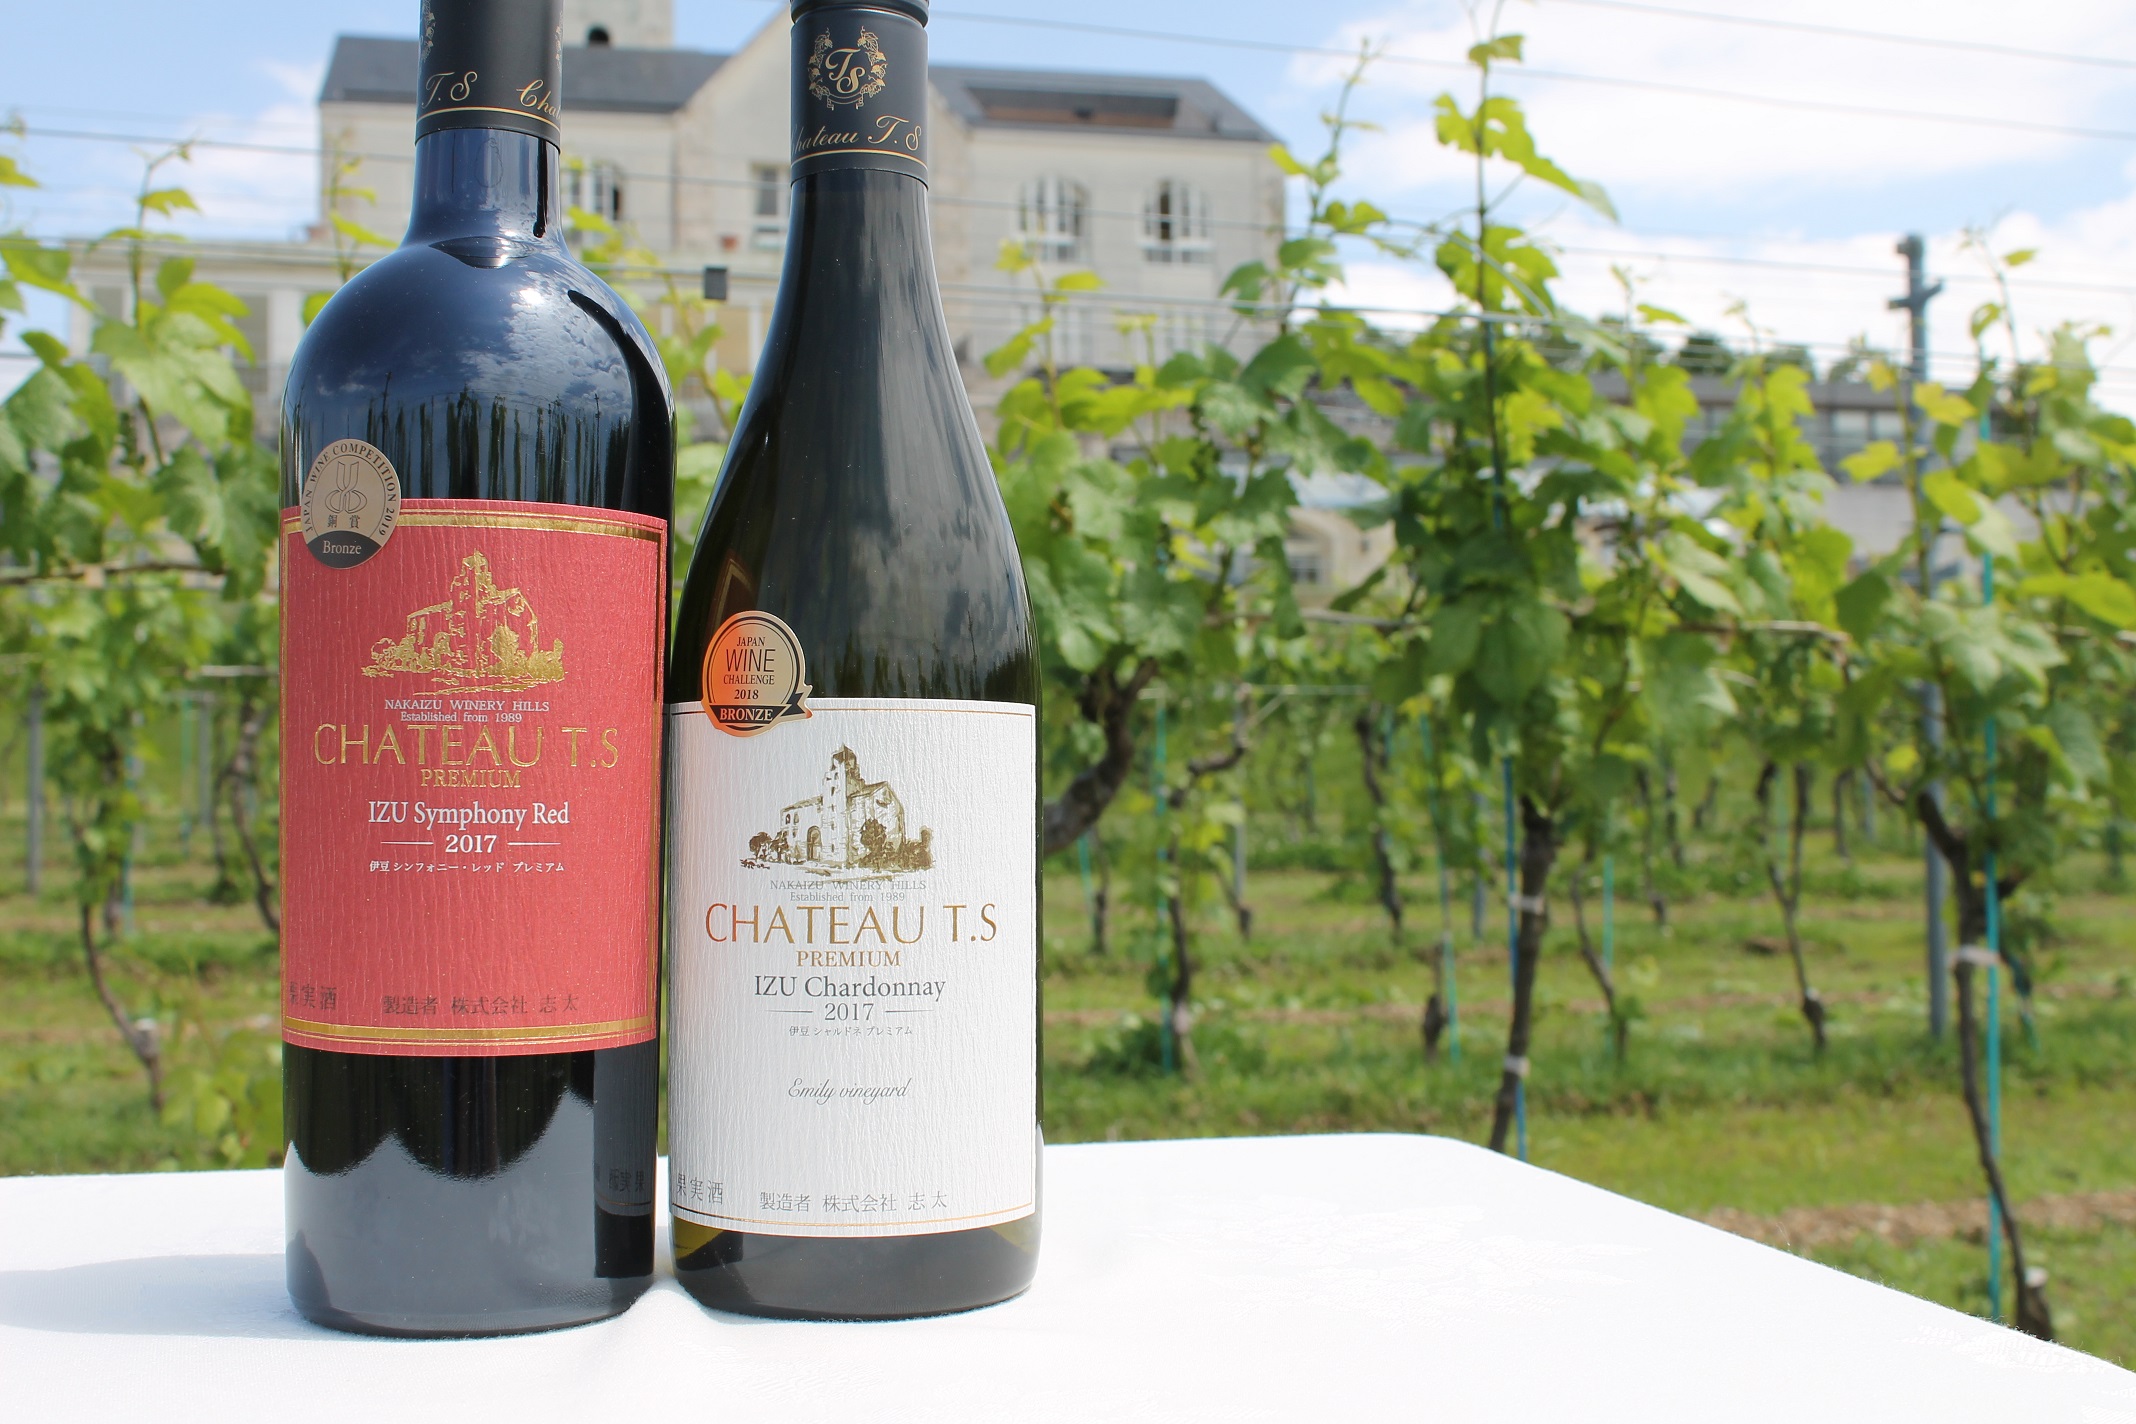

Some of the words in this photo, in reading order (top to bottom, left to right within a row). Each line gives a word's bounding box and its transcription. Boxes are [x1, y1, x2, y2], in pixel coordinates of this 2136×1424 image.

[791, 125, 859, 156] hateau
[302, 489, 314, 533] JAPAN
[310, 451, 331, 483] WINE
[332, 442, 398, 503] COMPETITION
[378, 507, 396, 537] 2019
[322, 540, 362, 555] Bronze
[736, 636, 766, 647] JAPAN
[726, 649, 776, 673] WINE
[723, 674, 776, 686] CHALLENGE
[734, 688, 759, 700] 2018
[384, 699, 443, 711] NAKAIZU
[450, 700, 505, 712] WINERY
[512, 700, 550, 712] HILLS
[719, 707, 774, 721] BRONZE
[400, 711, 457, 723] Established
[463, 712, 488, 723] from
[494, 712, 523, 723] 1989
[313, 723, 543, 768] CHATEAU
[561, 726, 619, 769] T.S
[420, 769, 521, 789] PREMIUM
[368, 801, 408, 824] IZU
[413, 801, 527, 832] Symphony
[532, 801, 570, 825] Red
[445, 834, 498, 854] 2017
[769, 880, 825, 891] NAKAIZU
[832, 880, 884, 891] WINERY
[891, 880, 927, 890] HILLS
[789, 891, 844, 902] Established
[850, 892, 874, 902] from
[880, 892, 905, 902] 1989
[705, 902, 925, 945] CHATEAU
[942, 903, 998, 943] T.S
[795, 950, 902, 968] PREMIUM
[754, 975, 798, 997] IZU
[804, 975, 946, 1002] Chardonnay
[823, 1002, 875, 1022] 2017
[787, 1077, 836, 1106] Emily
[839, 1077, 913, 1106] vineyard
[759, 1191, 812, 1214] 製造者
[821, 1192, 897, 1214] 株式会社
